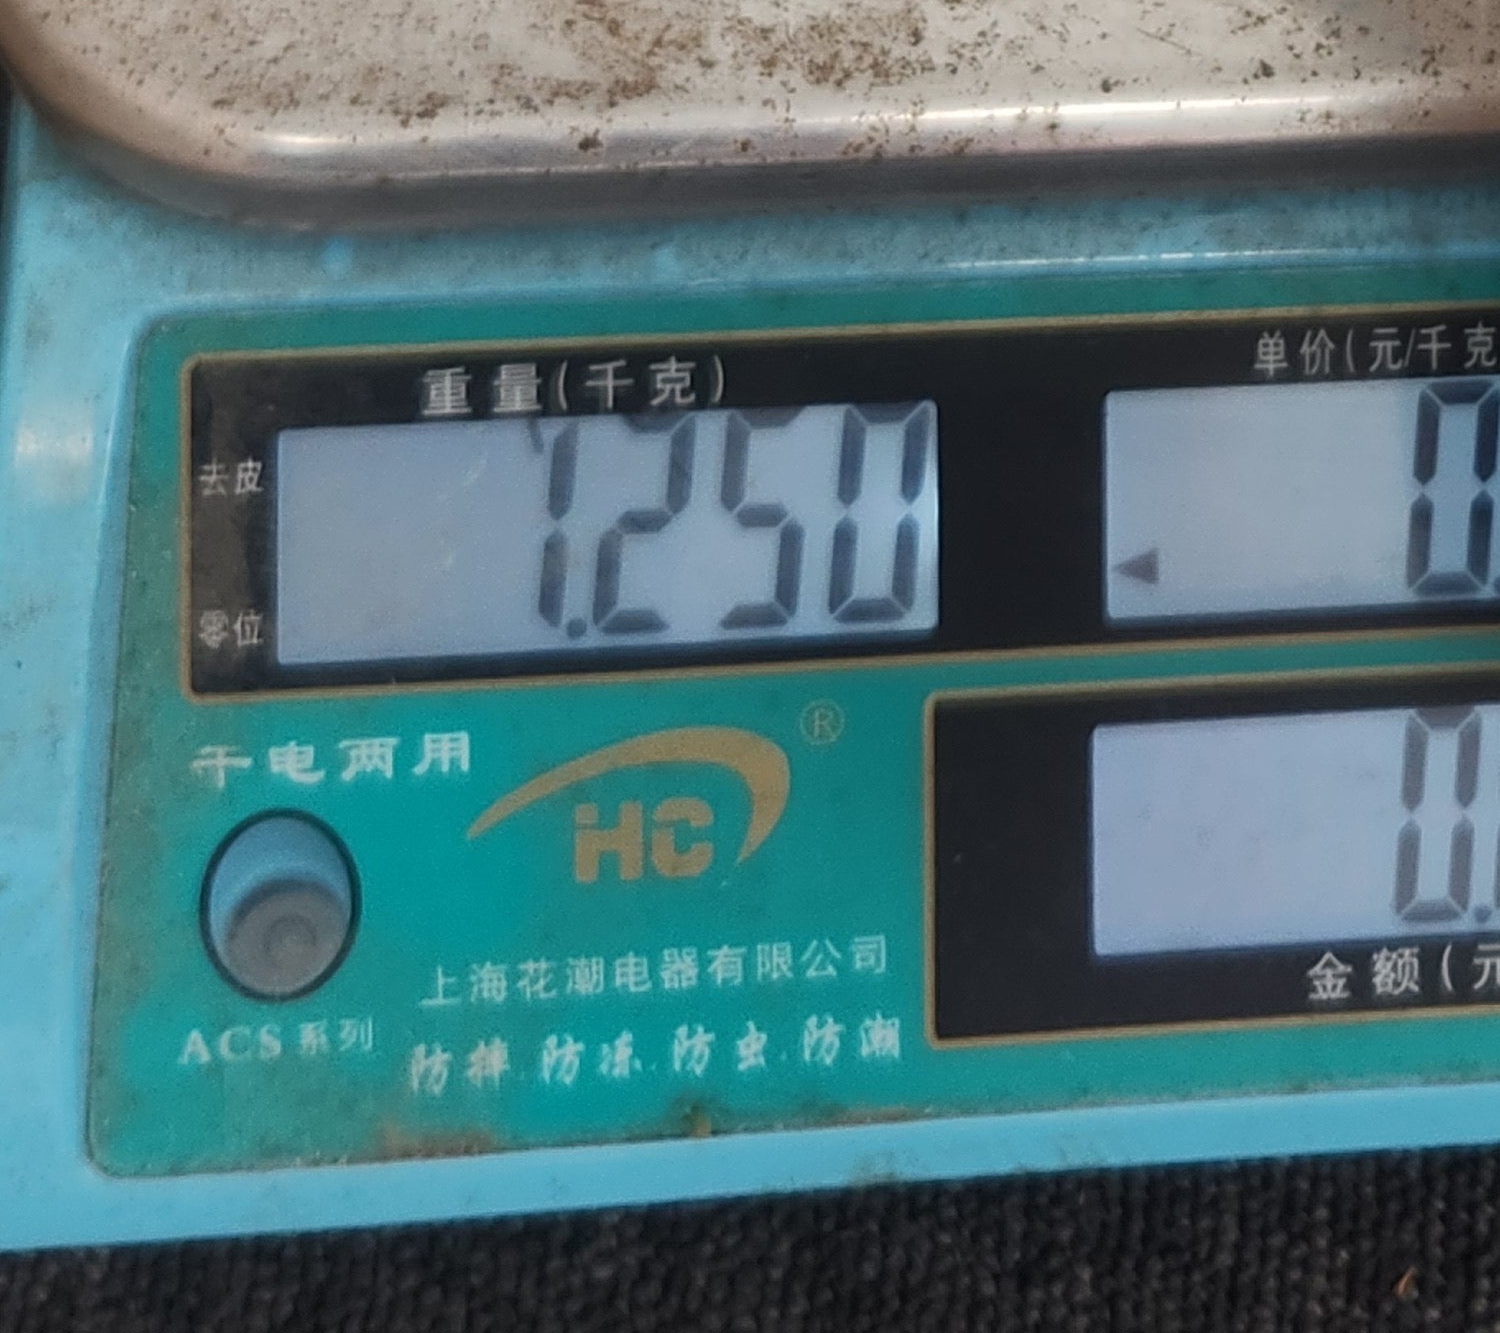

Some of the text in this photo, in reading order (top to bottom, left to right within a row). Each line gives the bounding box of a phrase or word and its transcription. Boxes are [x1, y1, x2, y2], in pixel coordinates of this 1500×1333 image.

[198, 457, 265, 496] 去皮
[198, 608, 265, 650] 零位
[574, 795, 714, 885] HC
[177, 1016, 374, 1065] ACS 系列
